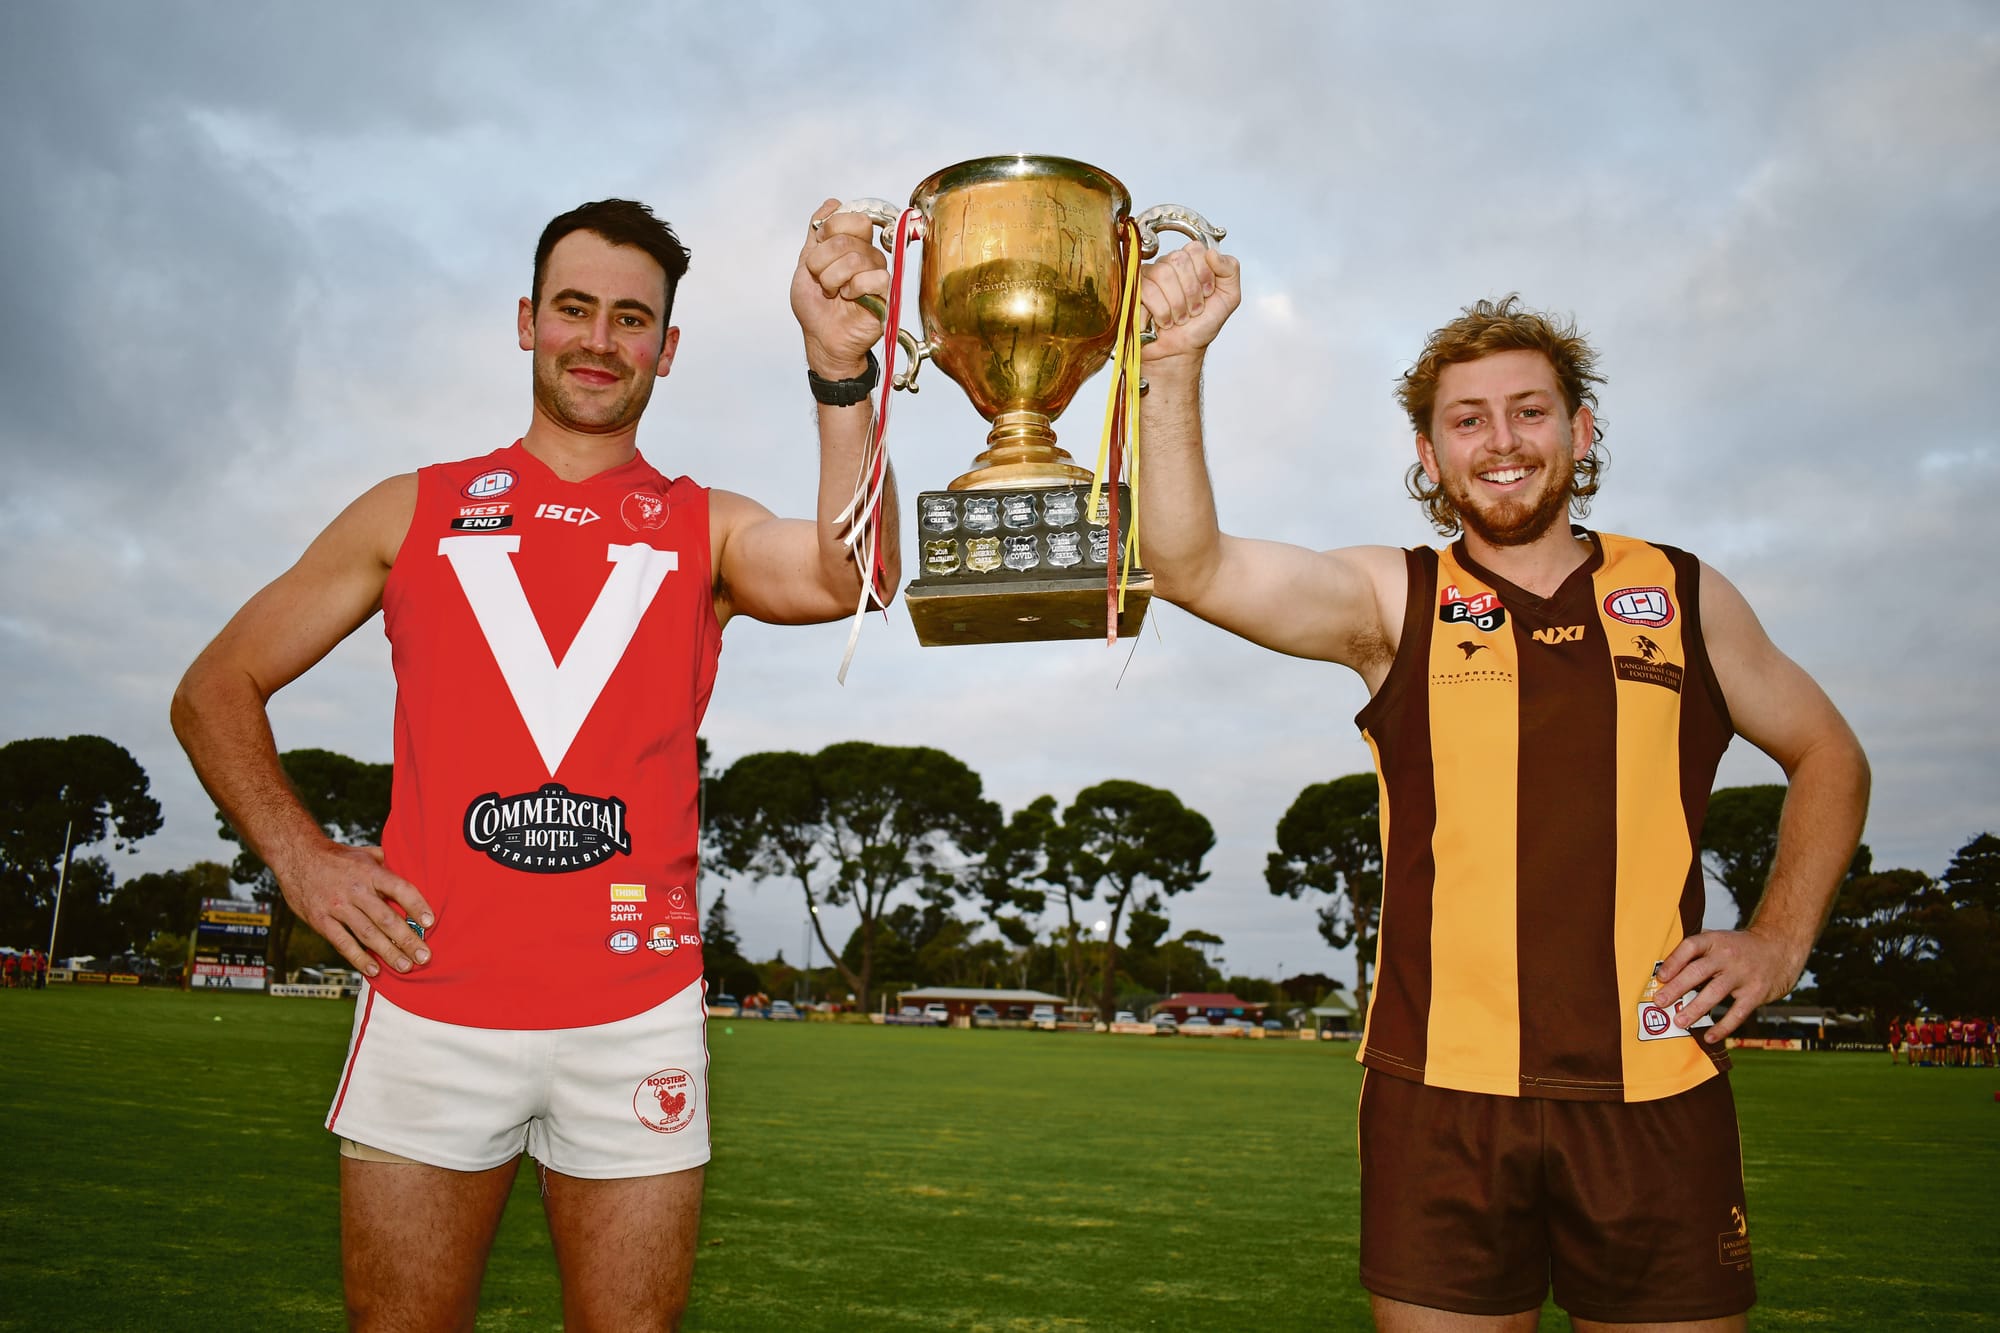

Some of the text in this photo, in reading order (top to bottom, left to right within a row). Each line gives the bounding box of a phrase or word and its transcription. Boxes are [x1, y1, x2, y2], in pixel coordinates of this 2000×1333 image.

[460, 505, 510, 516] WEST
[534, 503, 582, 523] ISC
[462, 518, 502, 528] END
[1010, 552, 1033, 560] COVID
[1447, 587, 1496, 613] WST
[438, 535, 679, 779] V
[1620, 662, 1664, 675] LANGHORNE
[1629, 671, 1664, 682] FOOTBALL
[469, 797, 627, 849] COMMERCIAL
[524, 829, 578, 851] HOTEL
[492, 843, 611, 866] STRATHALBYN
[611, 904, 636, 913] ROAD
[611, 913, 643, 921] SAFETY
[646, 938, 679, 950] SANFL
[647, 1074, 686, 1087] ROOSTERS
